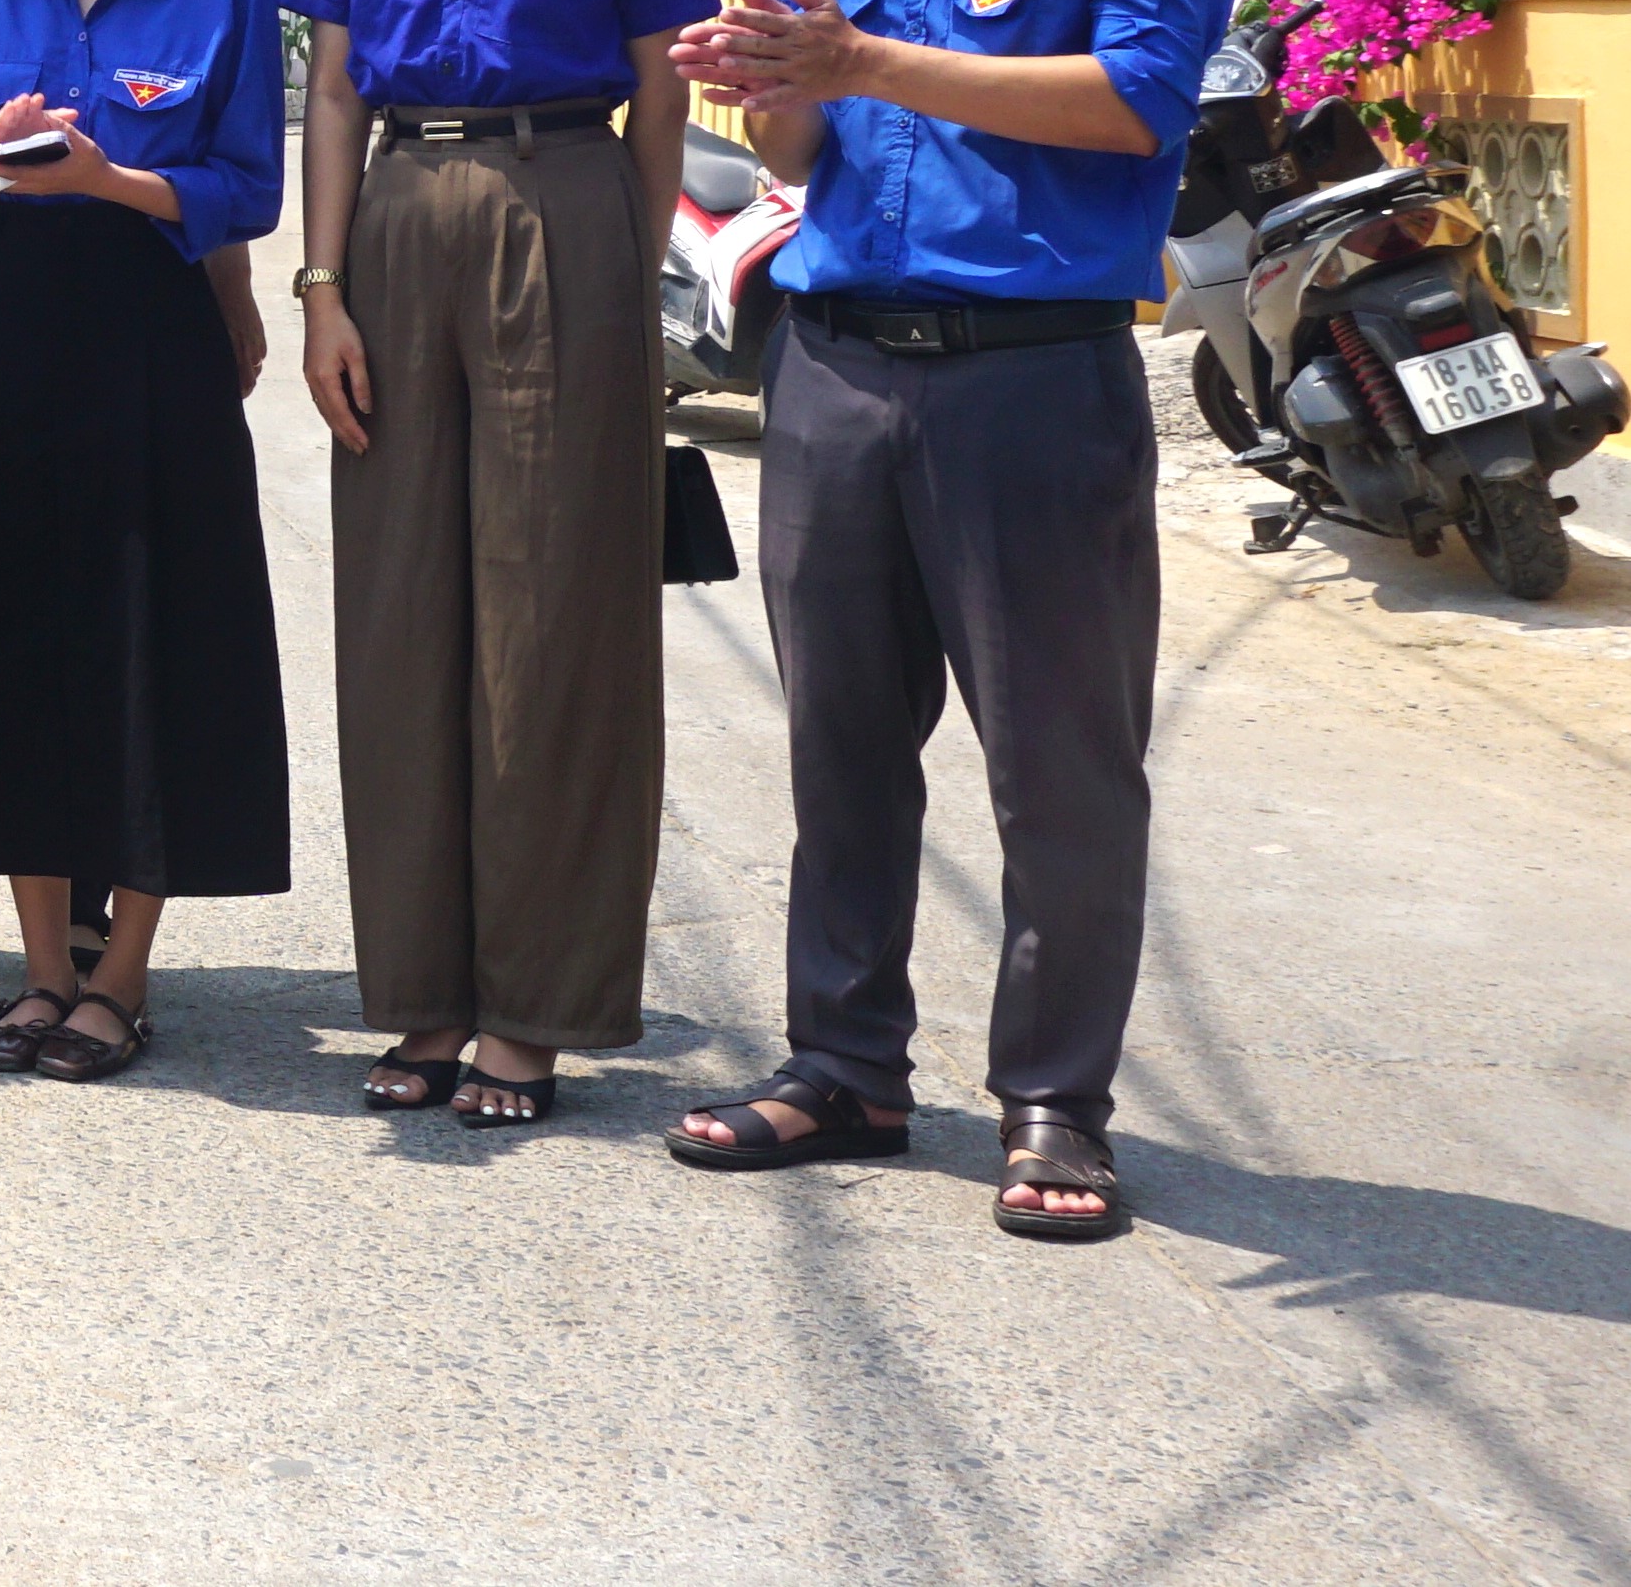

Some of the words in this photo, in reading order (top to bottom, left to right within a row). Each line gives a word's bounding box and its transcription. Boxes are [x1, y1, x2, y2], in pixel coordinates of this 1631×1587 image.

[909, 327, 923, 341] A
[1419, 344, 1507, 392] 18-AA
[1424, 373, 1533, 426] 160.58
